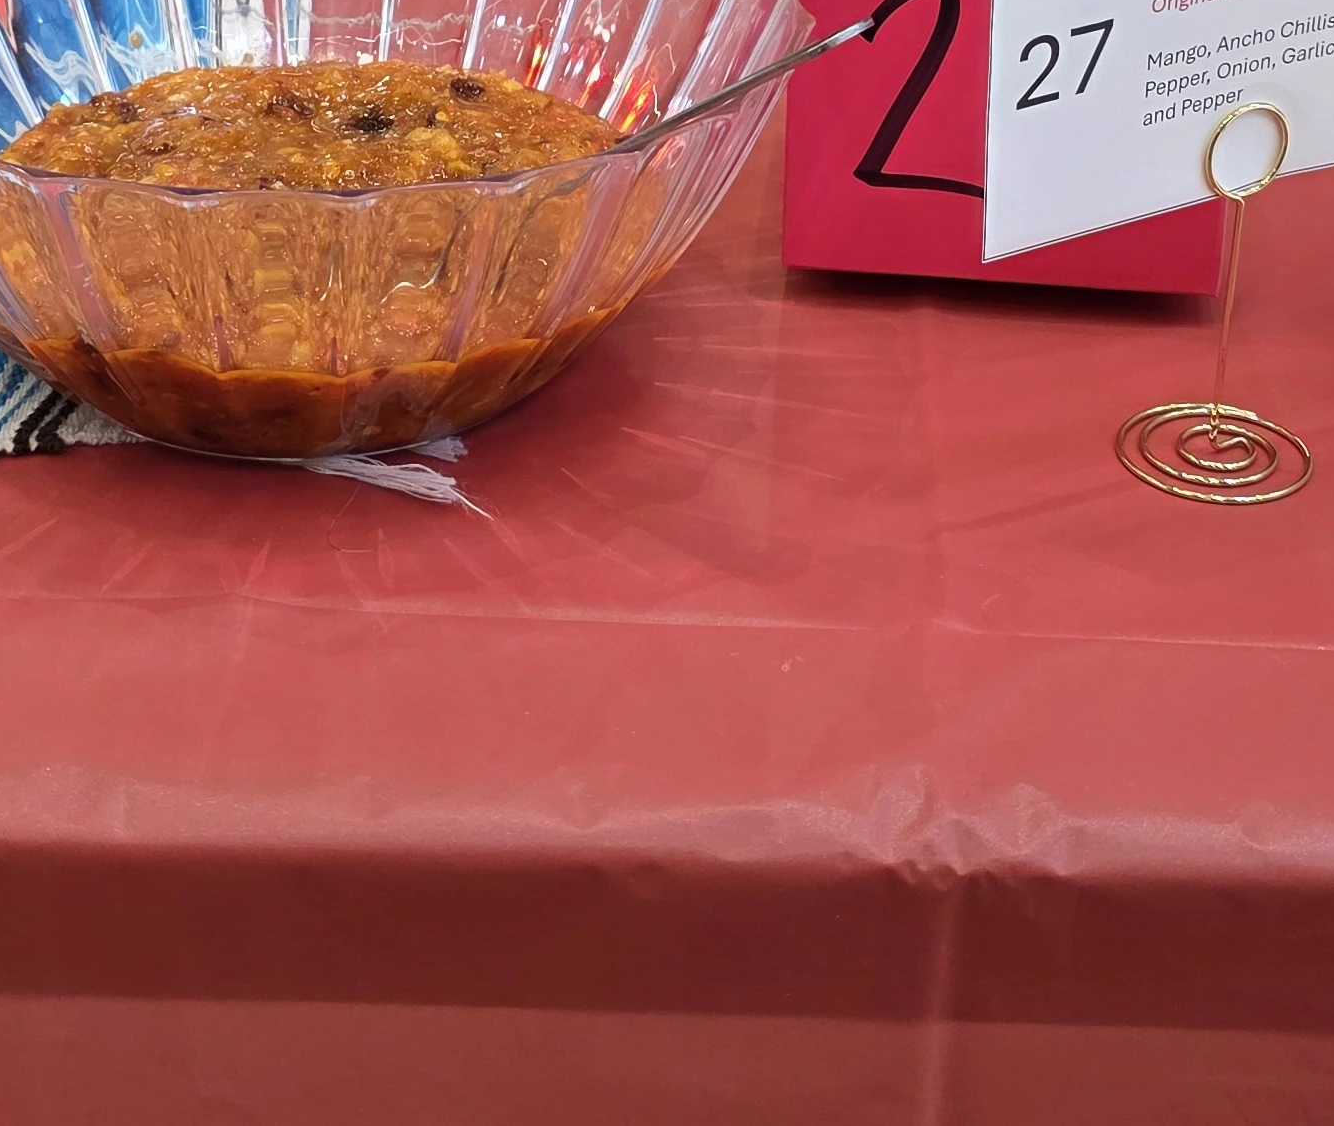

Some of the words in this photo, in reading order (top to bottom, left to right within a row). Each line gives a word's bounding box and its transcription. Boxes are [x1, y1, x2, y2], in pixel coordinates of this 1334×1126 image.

[1016, 17, 1114, 112] 27
[1147, 42, 1212, 71] Mango,
[1216, 27, 1275, 54] Ancho
[1144, 69, 1211, 99] Pepper,
[1216, 53, 1277, 80] Onion,
[1141, 102, 1176, 127] and
[1180, 86, 1245, 117] Pepper
